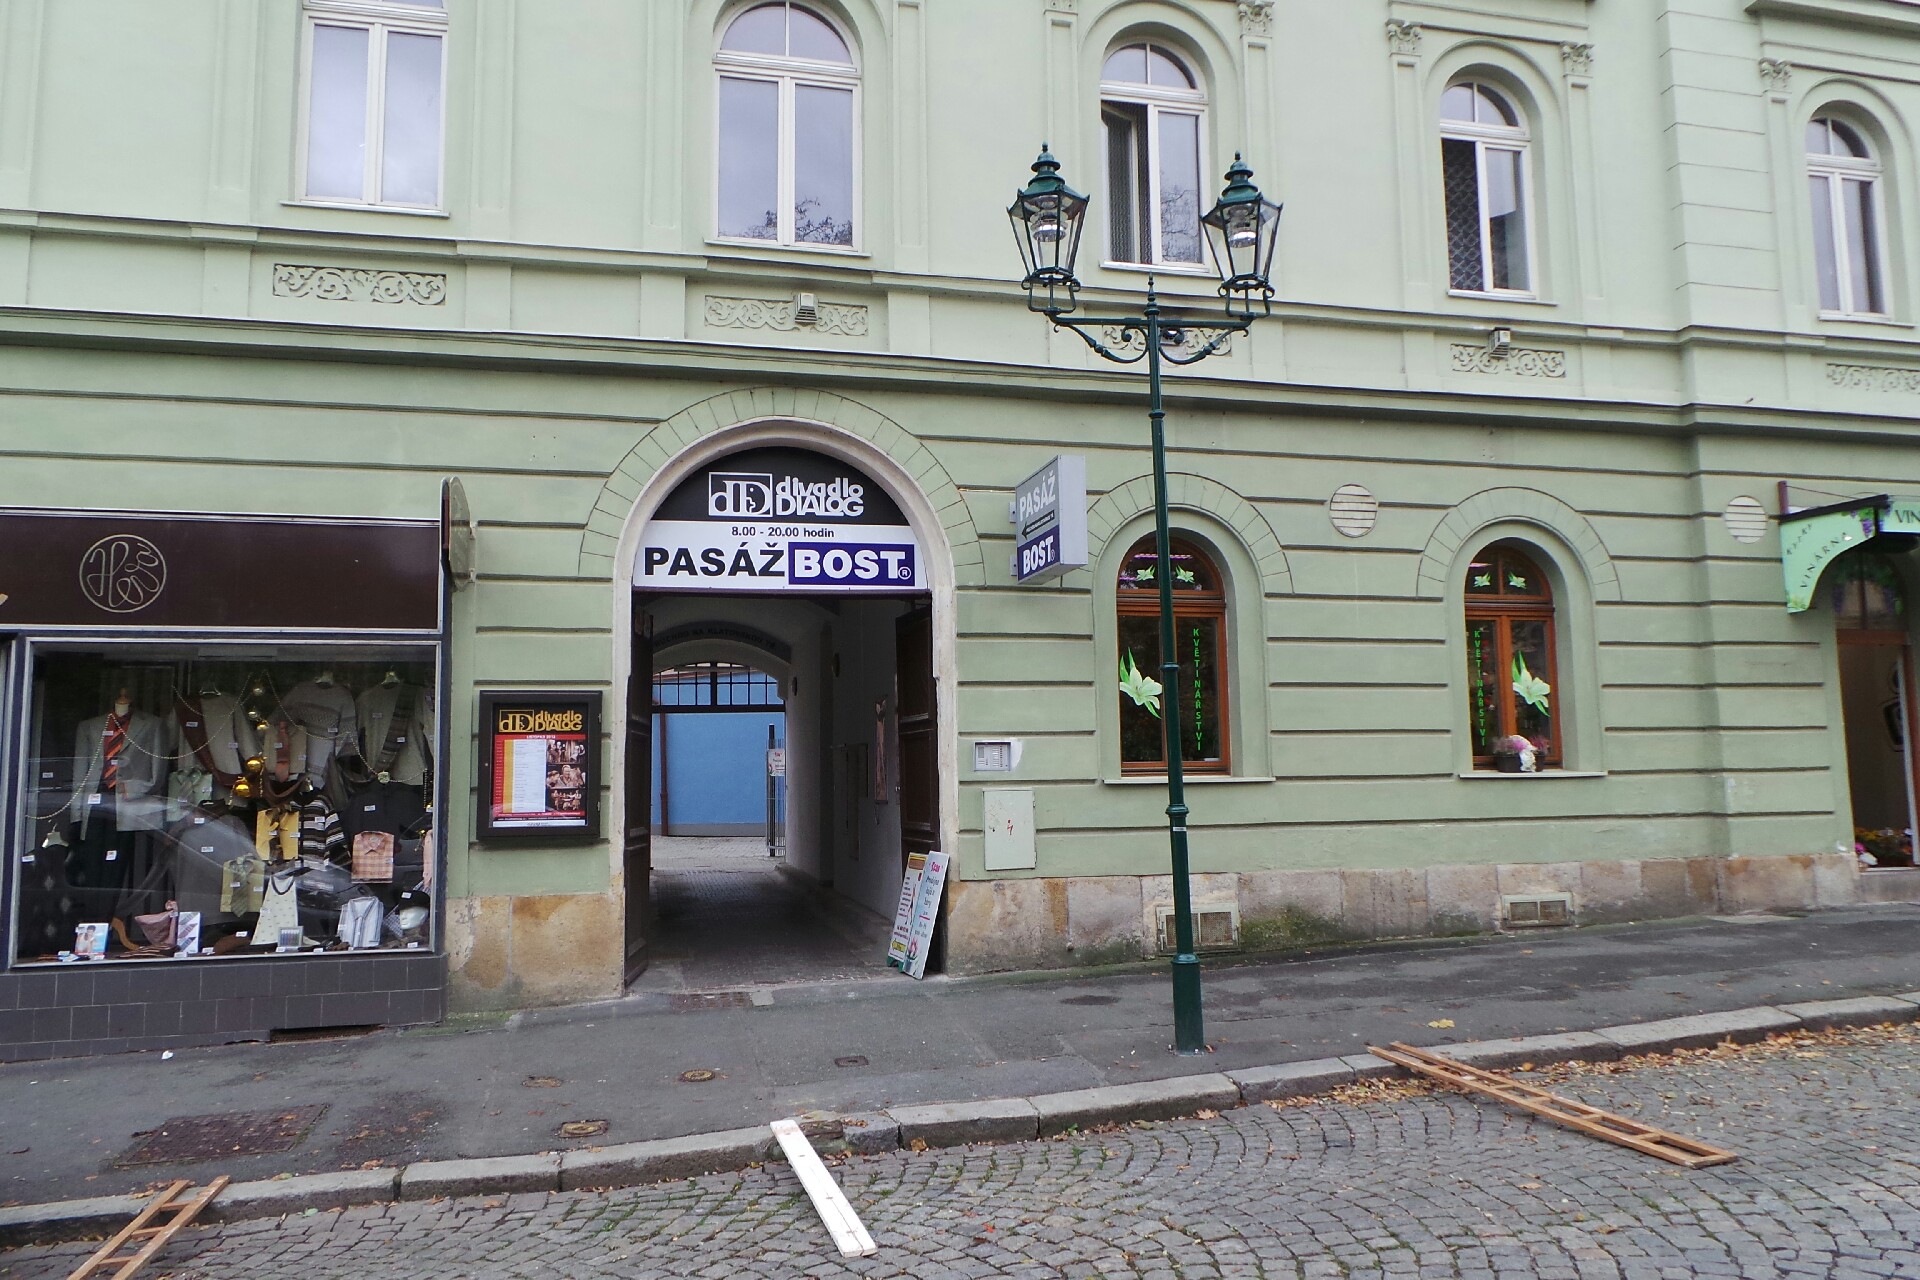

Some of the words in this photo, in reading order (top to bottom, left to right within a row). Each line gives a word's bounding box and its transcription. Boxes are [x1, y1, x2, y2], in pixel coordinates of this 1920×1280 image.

[776, 476, 864, 497] divadlo
[1020, 470, 1056, 522] PASÁŽ
[776, 494, 864, 517] DIALOG
[731, 526, 756, 536] 8.00
[767, 527, 799, 537] 20.00
[803, 528, 835, 538] hodin
[644, 541, 786, 577] PASÁŽ
[535, 710, 583, 721] divadlo
[535, 719, 583, 732] DIALOG
